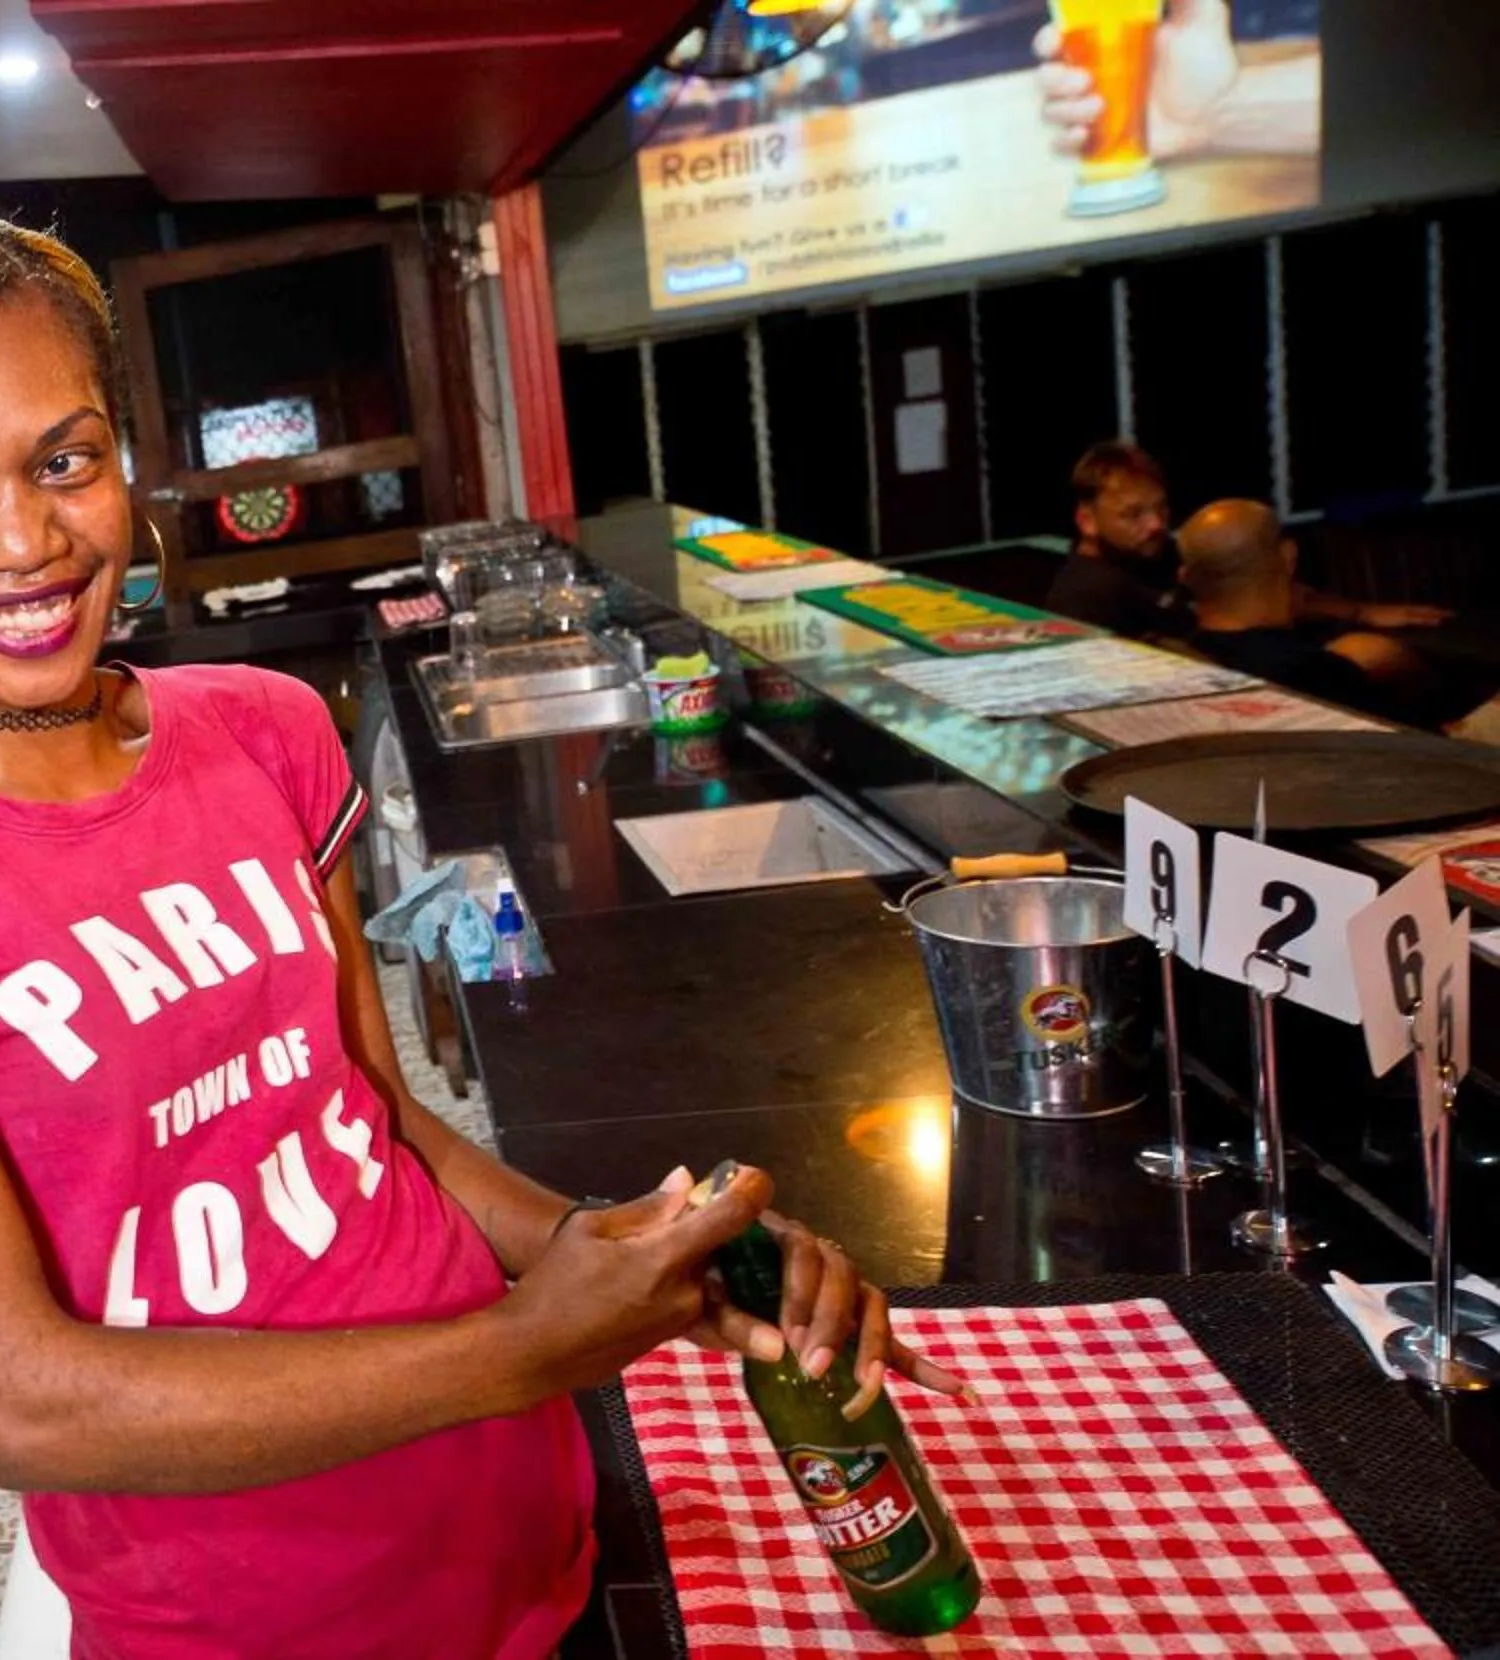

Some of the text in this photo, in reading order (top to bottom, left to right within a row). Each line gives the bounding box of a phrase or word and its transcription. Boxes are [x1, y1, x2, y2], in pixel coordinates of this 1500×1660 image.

[661, 134, 787, 189] Refill?
[702, 191, 753, 213] time
[761, 180, 793, 203] for
[799, 177, 819, 197] a
[822, 162, 882, 193] short
[888, 153, 961, 184] break
[1151, 839, 1176, 923] 9
[1260, 880, 1317, 979] 2
[1386, 914, 1424, 1017] 6
[148, 1027, 313, 1150] TOWN OF
[102, 1086, 385, 1328] LOVE
